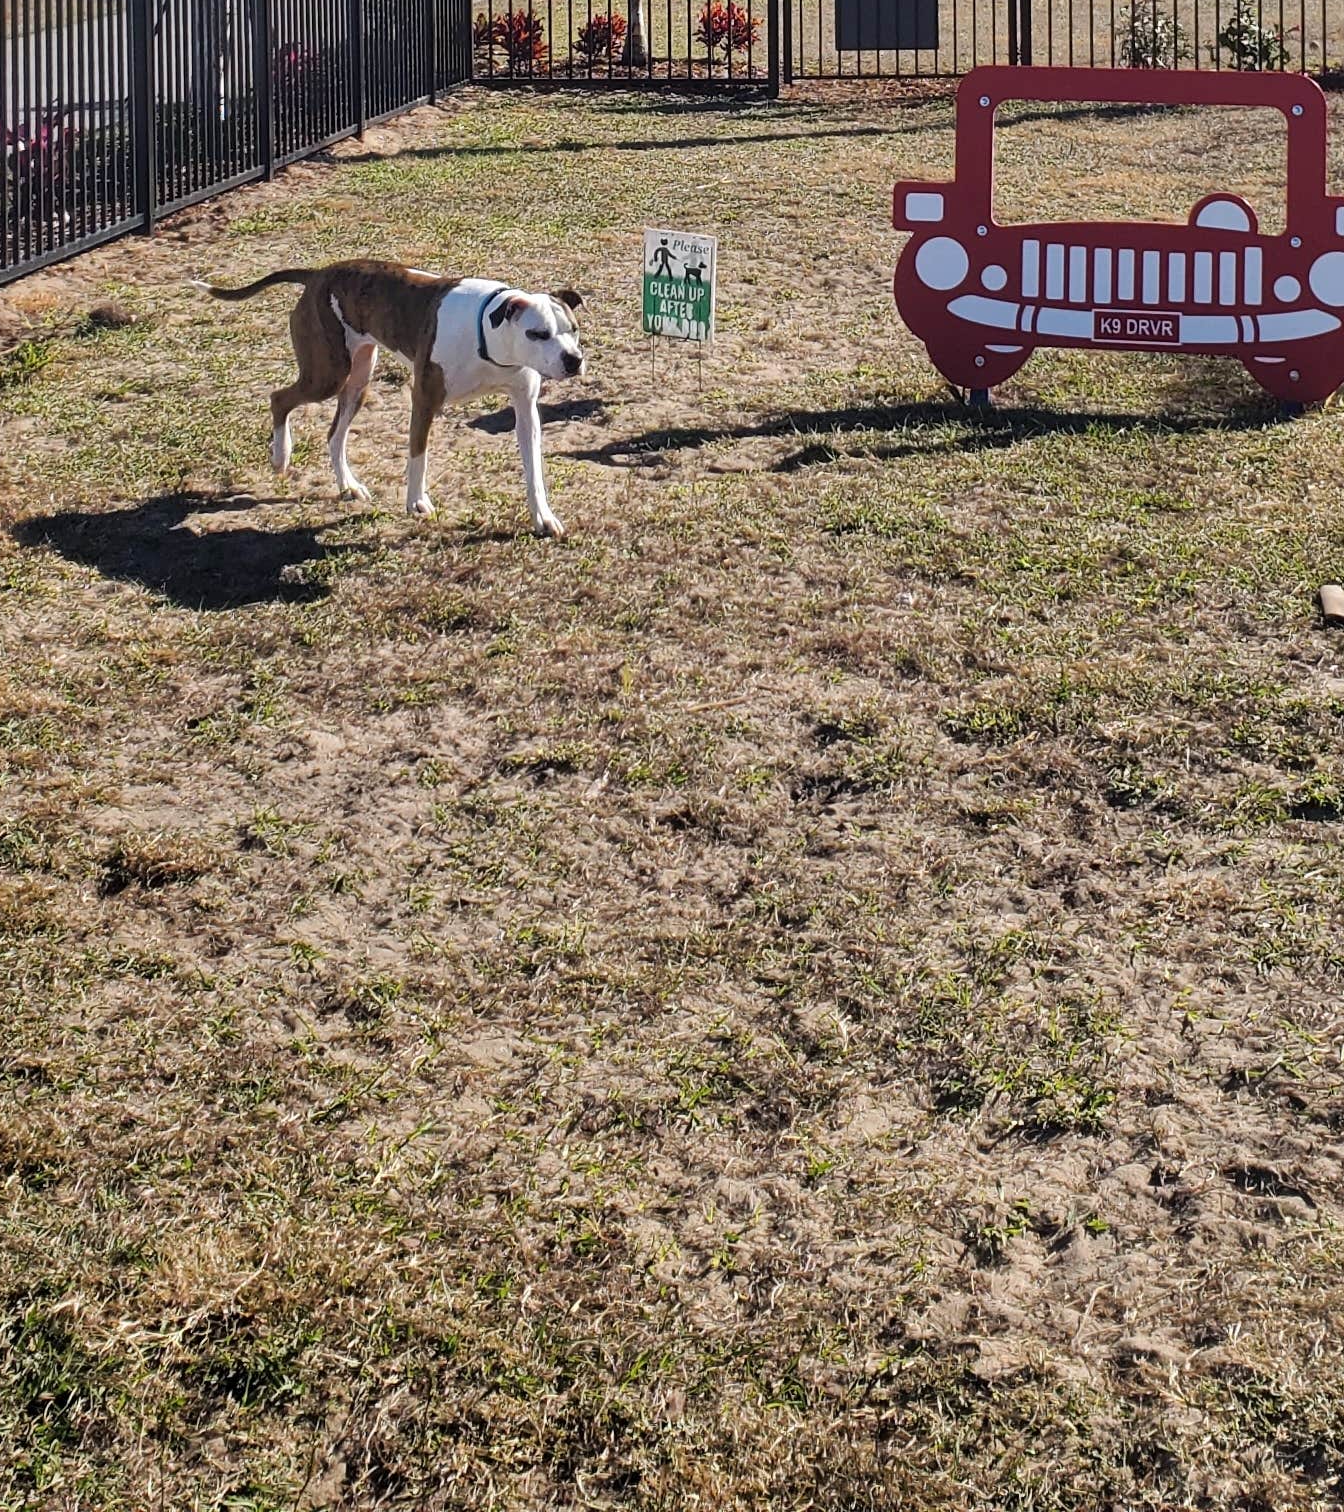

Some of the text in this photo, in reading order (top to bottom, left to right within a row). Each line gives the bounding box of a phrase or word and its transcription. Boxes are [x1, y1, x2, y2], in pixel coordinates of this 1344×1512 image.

[673, 239, 710, 255] Please
[649, 281, 705, 302] CLEAN UP
[659, 299, 694, 320] AFTER
[1100, 317, 1174, 337] K9 DRVR
